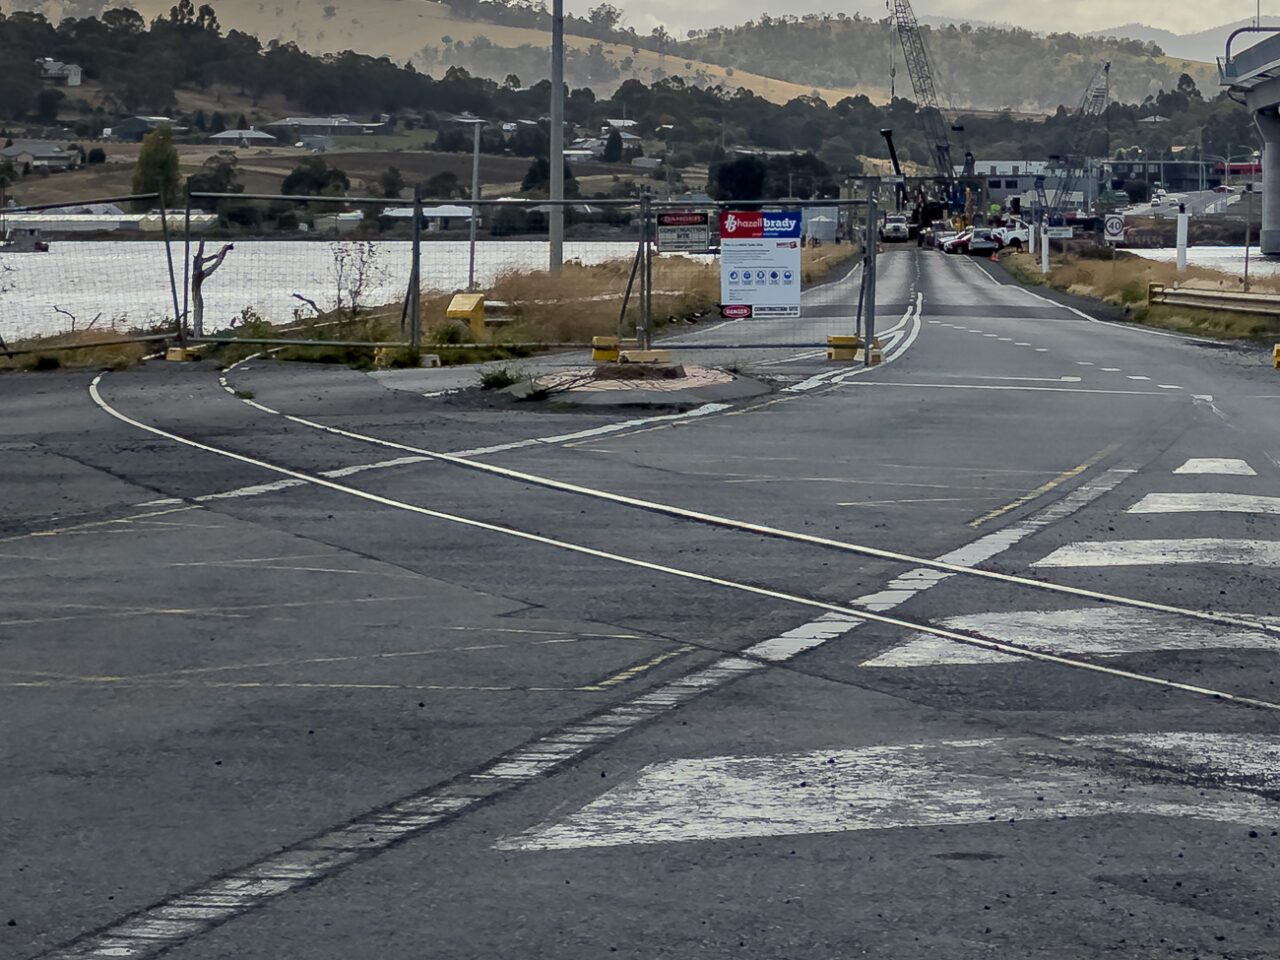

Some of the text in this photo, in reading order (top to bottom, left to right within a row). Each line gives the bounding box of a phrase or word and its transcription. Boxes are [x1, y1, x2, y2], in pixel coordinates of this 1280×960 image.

[737, 218, 797, 231] hazell brady
[1108, 222, 1120, 230] 40
